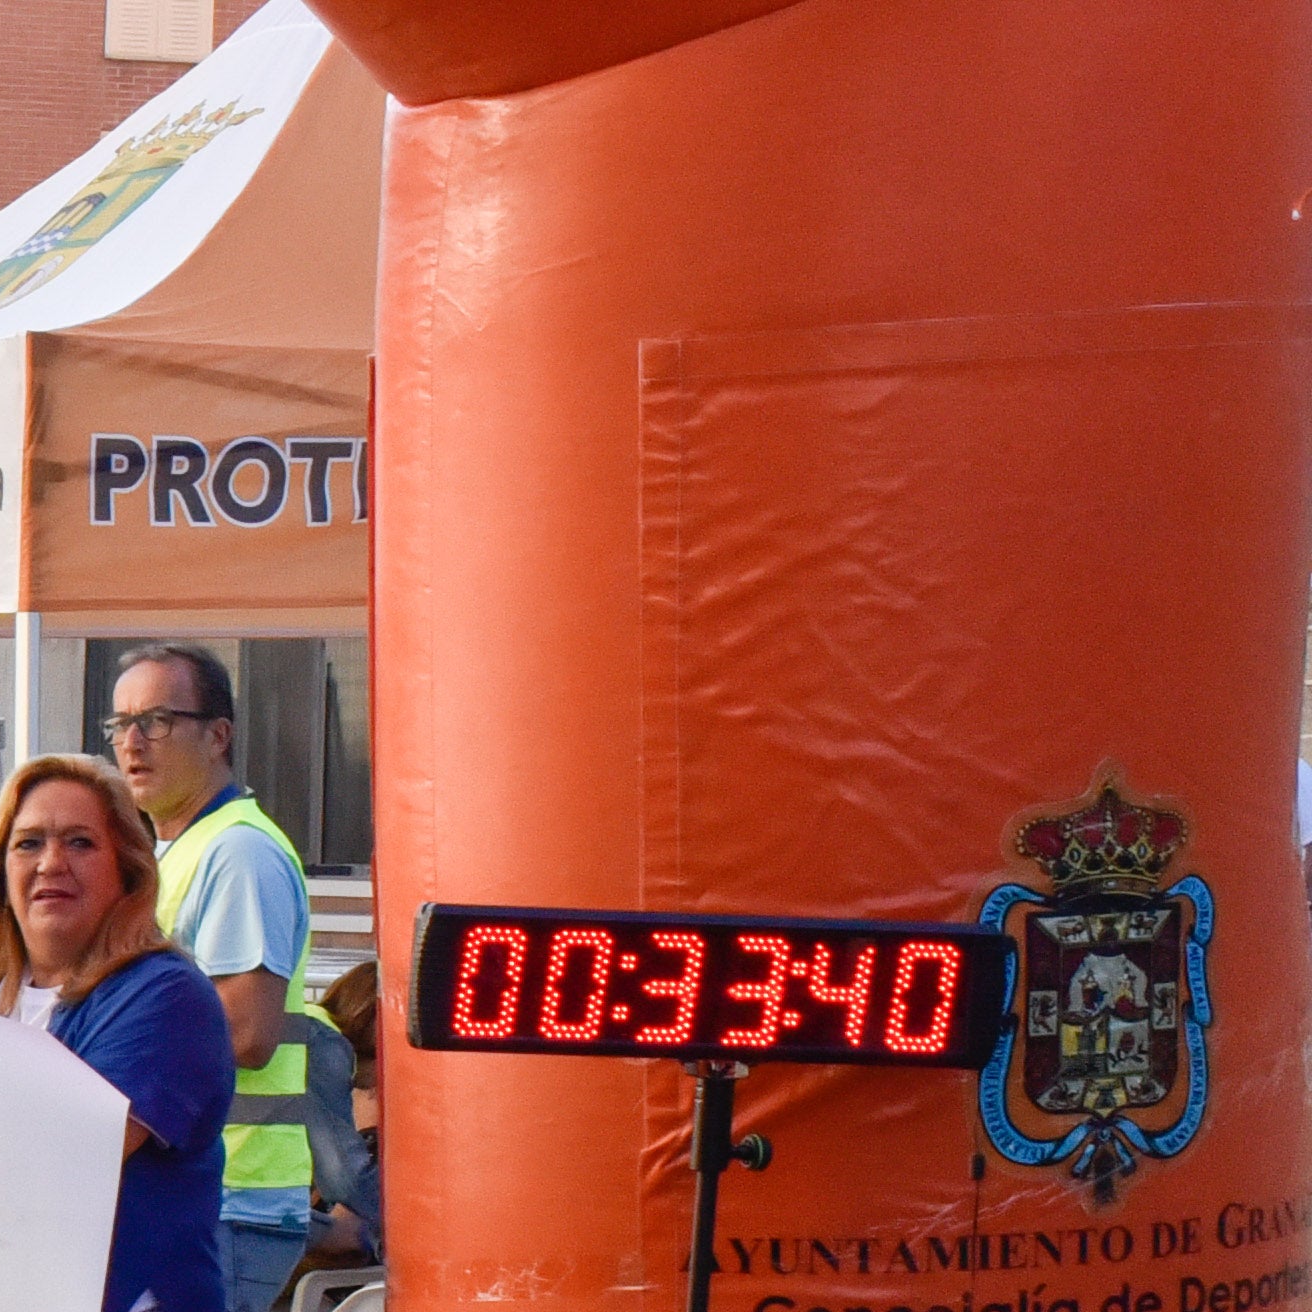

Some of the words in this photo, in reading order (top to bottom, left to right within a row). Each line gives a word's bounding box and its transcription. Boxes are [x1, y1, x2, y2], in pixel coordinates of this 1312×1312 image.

[89, 432, 370, 528] PROT
[451, 925, 961, 1053] 00:33:40
[1151, 1216, 1202, 1259] DE
